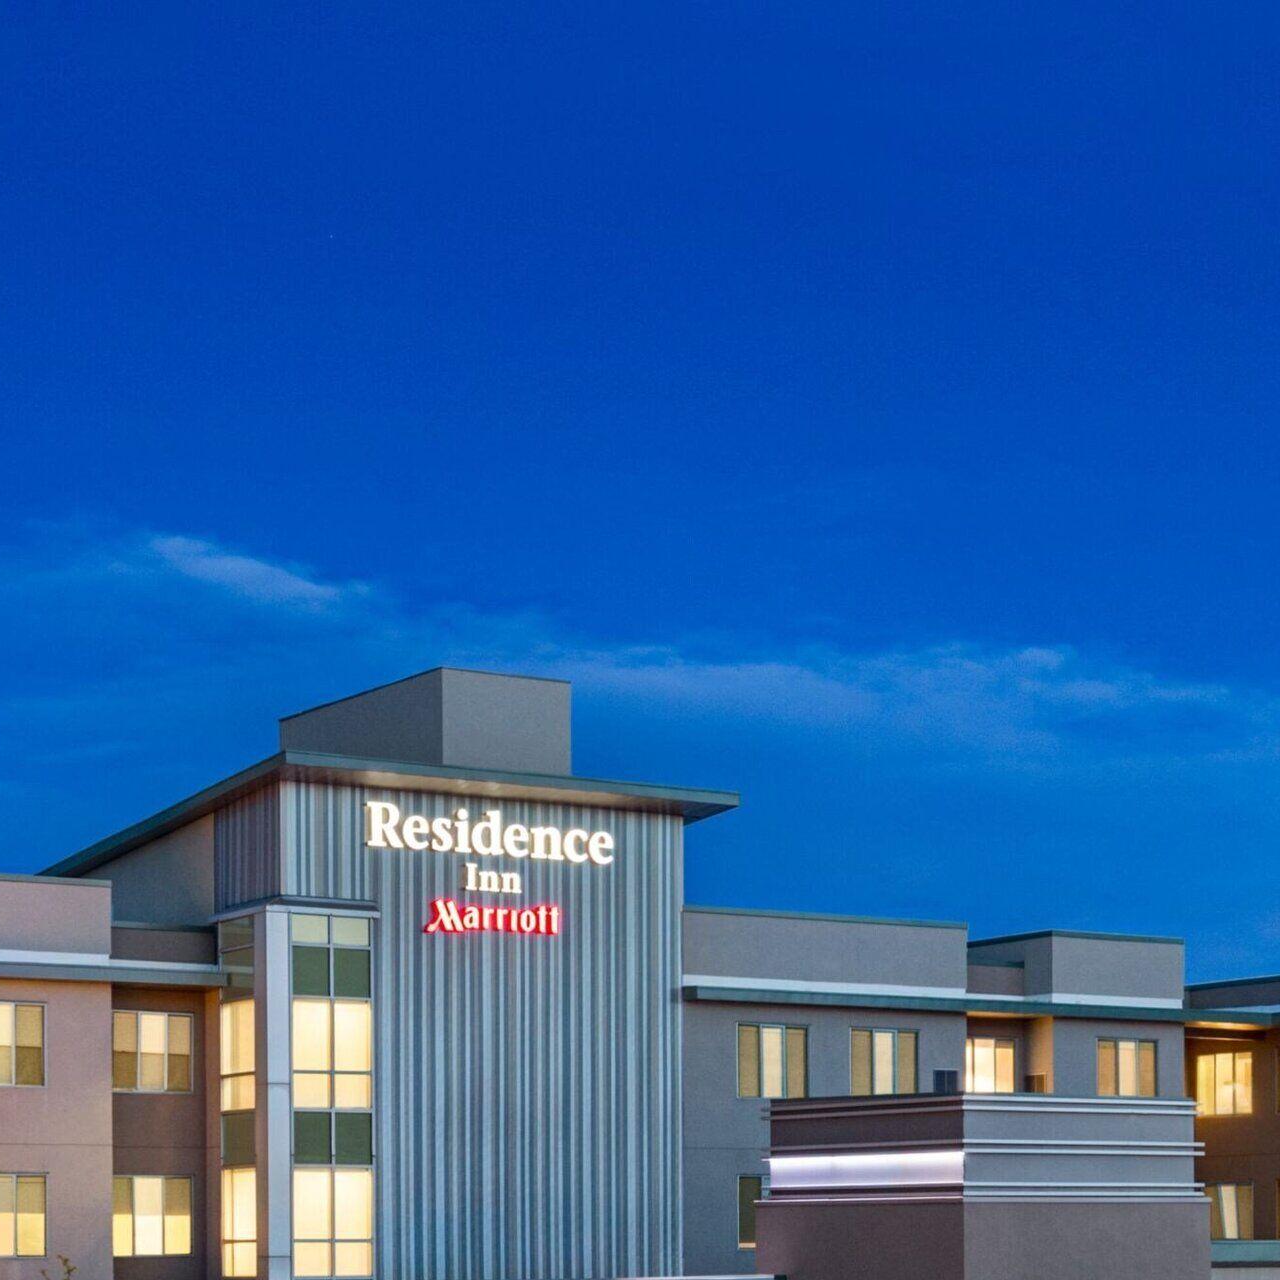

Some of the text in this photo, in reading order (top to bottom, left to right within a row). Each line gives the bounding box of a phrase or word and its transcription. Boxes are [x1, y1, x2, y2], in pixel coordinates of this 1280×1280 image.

[365, 801, 615, 865] Residence
[464, 862, 522, 893] Inn
[424, 898, 561, 935] Marriott
